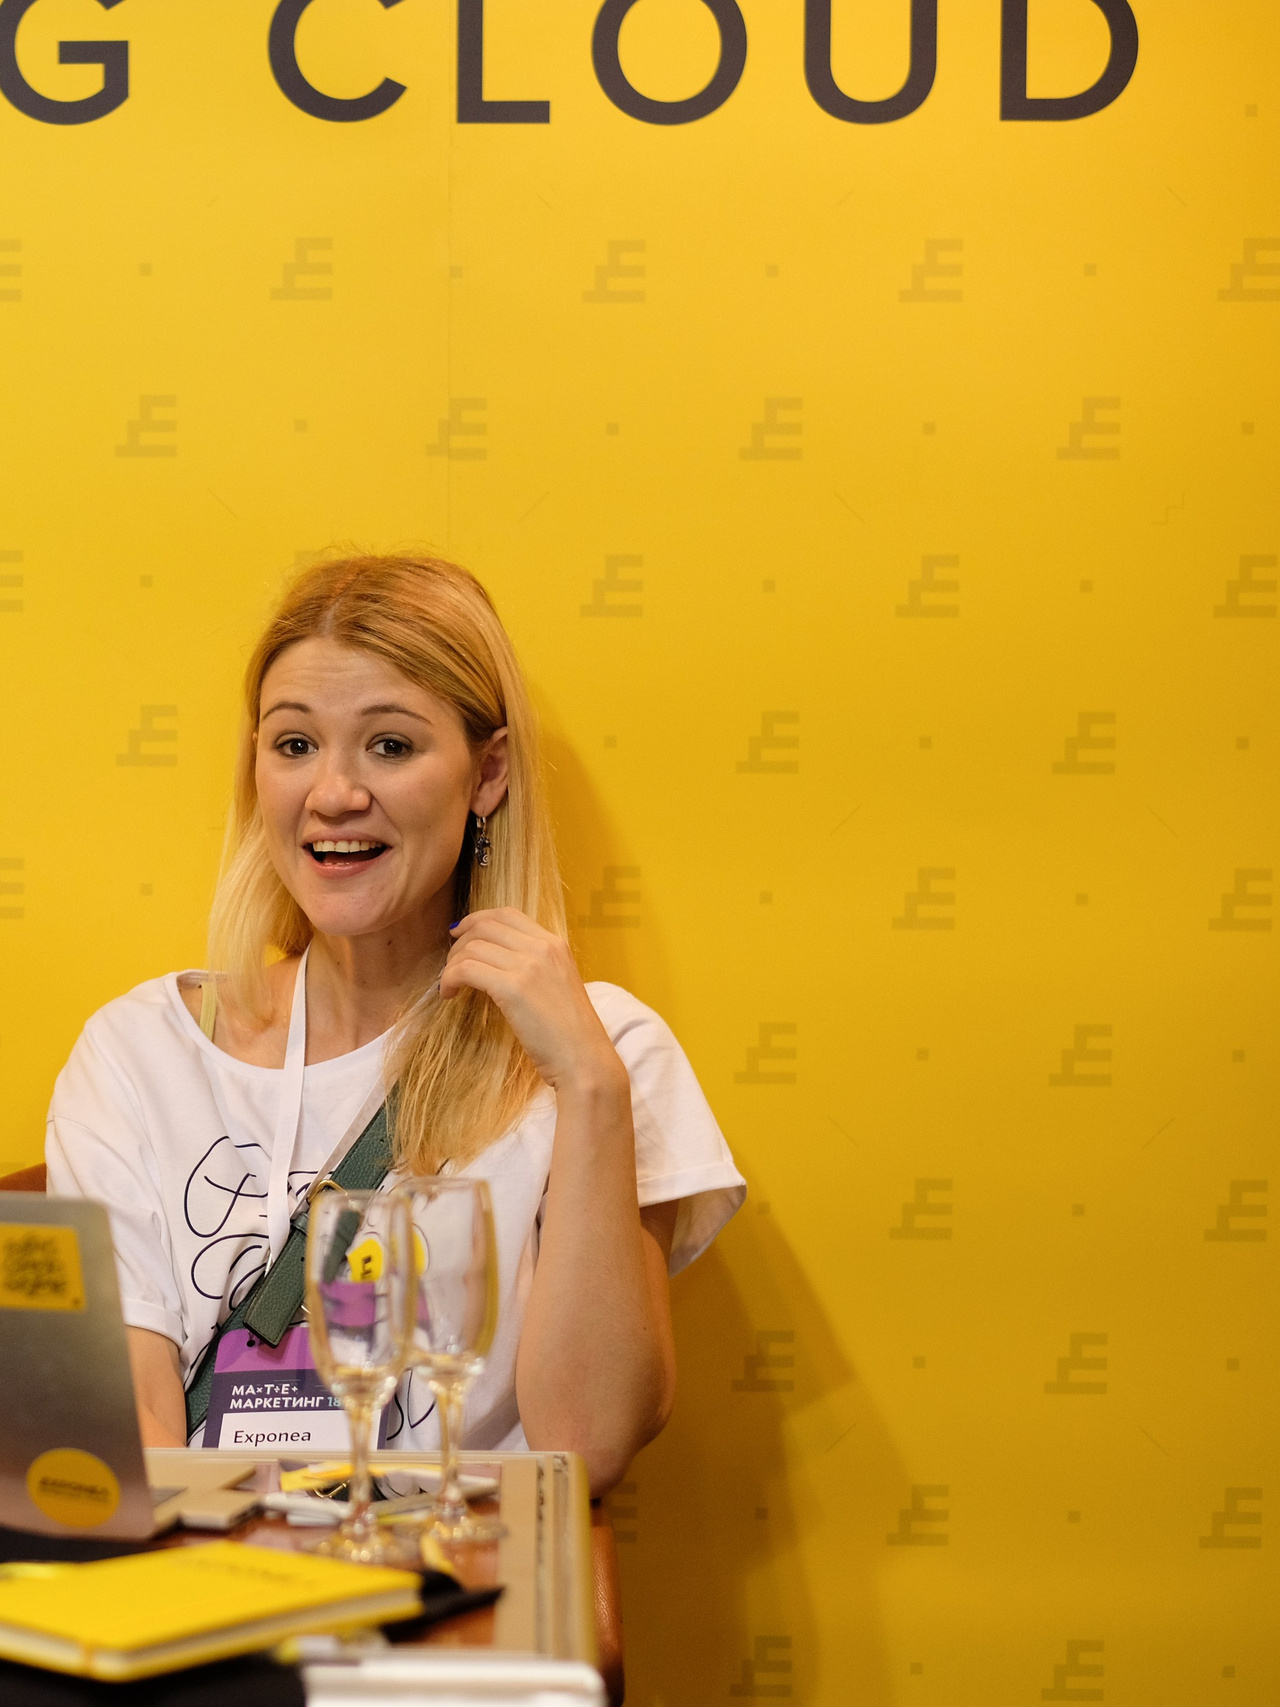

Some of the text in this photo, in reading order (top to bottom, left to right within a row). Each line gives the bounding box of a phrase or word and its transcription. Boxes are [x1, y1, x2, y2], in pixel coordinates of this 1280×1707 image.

[267, 0, 1139, 125] CLOUD
[229, 1396, 324, 1410] МАРКЕТИНГ
[233, 1430, 311, 1447] Exponea
